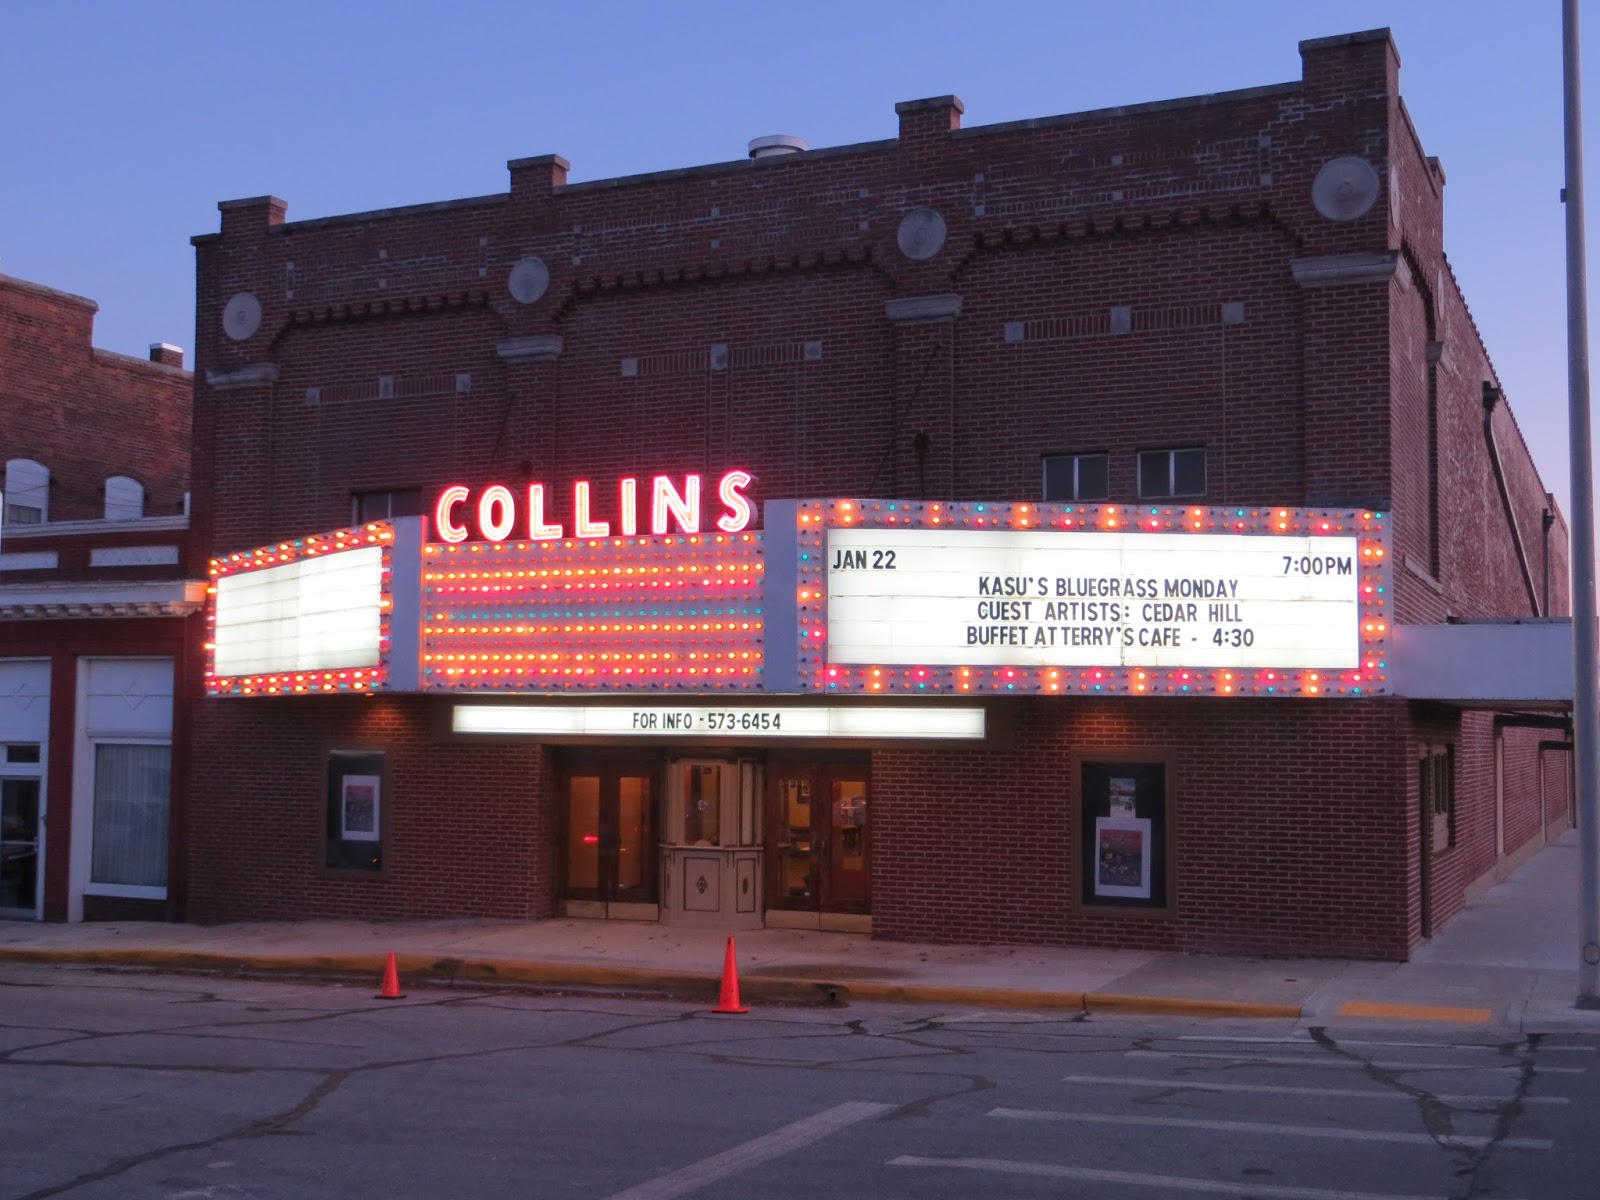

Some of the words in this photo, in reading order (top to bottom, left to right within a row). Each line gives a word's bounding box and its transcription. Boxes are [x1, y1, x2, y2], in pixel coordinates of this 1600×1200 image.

[436, 470, 752, 543] COLLINS
[832, 549, 867, 570] JAN
[872, 549, 897, 570] 22
[1283, 556, 1352, 576] 7:00PM
[978, 576, 1049, 596] KASU'S
[1055, 577, 1159, 598] BLUEGRASS
[1164, 578, 1239, 598] MONDAY
[977, 601, 1032, 621] GUEST
[1044, 601, 1131, 622] ARTISTS:
[1142, 603, 1198, 622] CEDAR
[1208, 603, 1243, 622] HILL
[966, 625, 1029, 645] BUFFET
[1033, 626, 1058, 645] AT
[1061, 626, 1135, 647] TERRY'S
[1138, 627, 1181, 647] CAFE
[1212, 627, 1255, 648] 4:30
[632, 712, 658, 729] FOR
[662, 712, 693, 729] INFO
[707, 712, 782, 730] 573-6454
